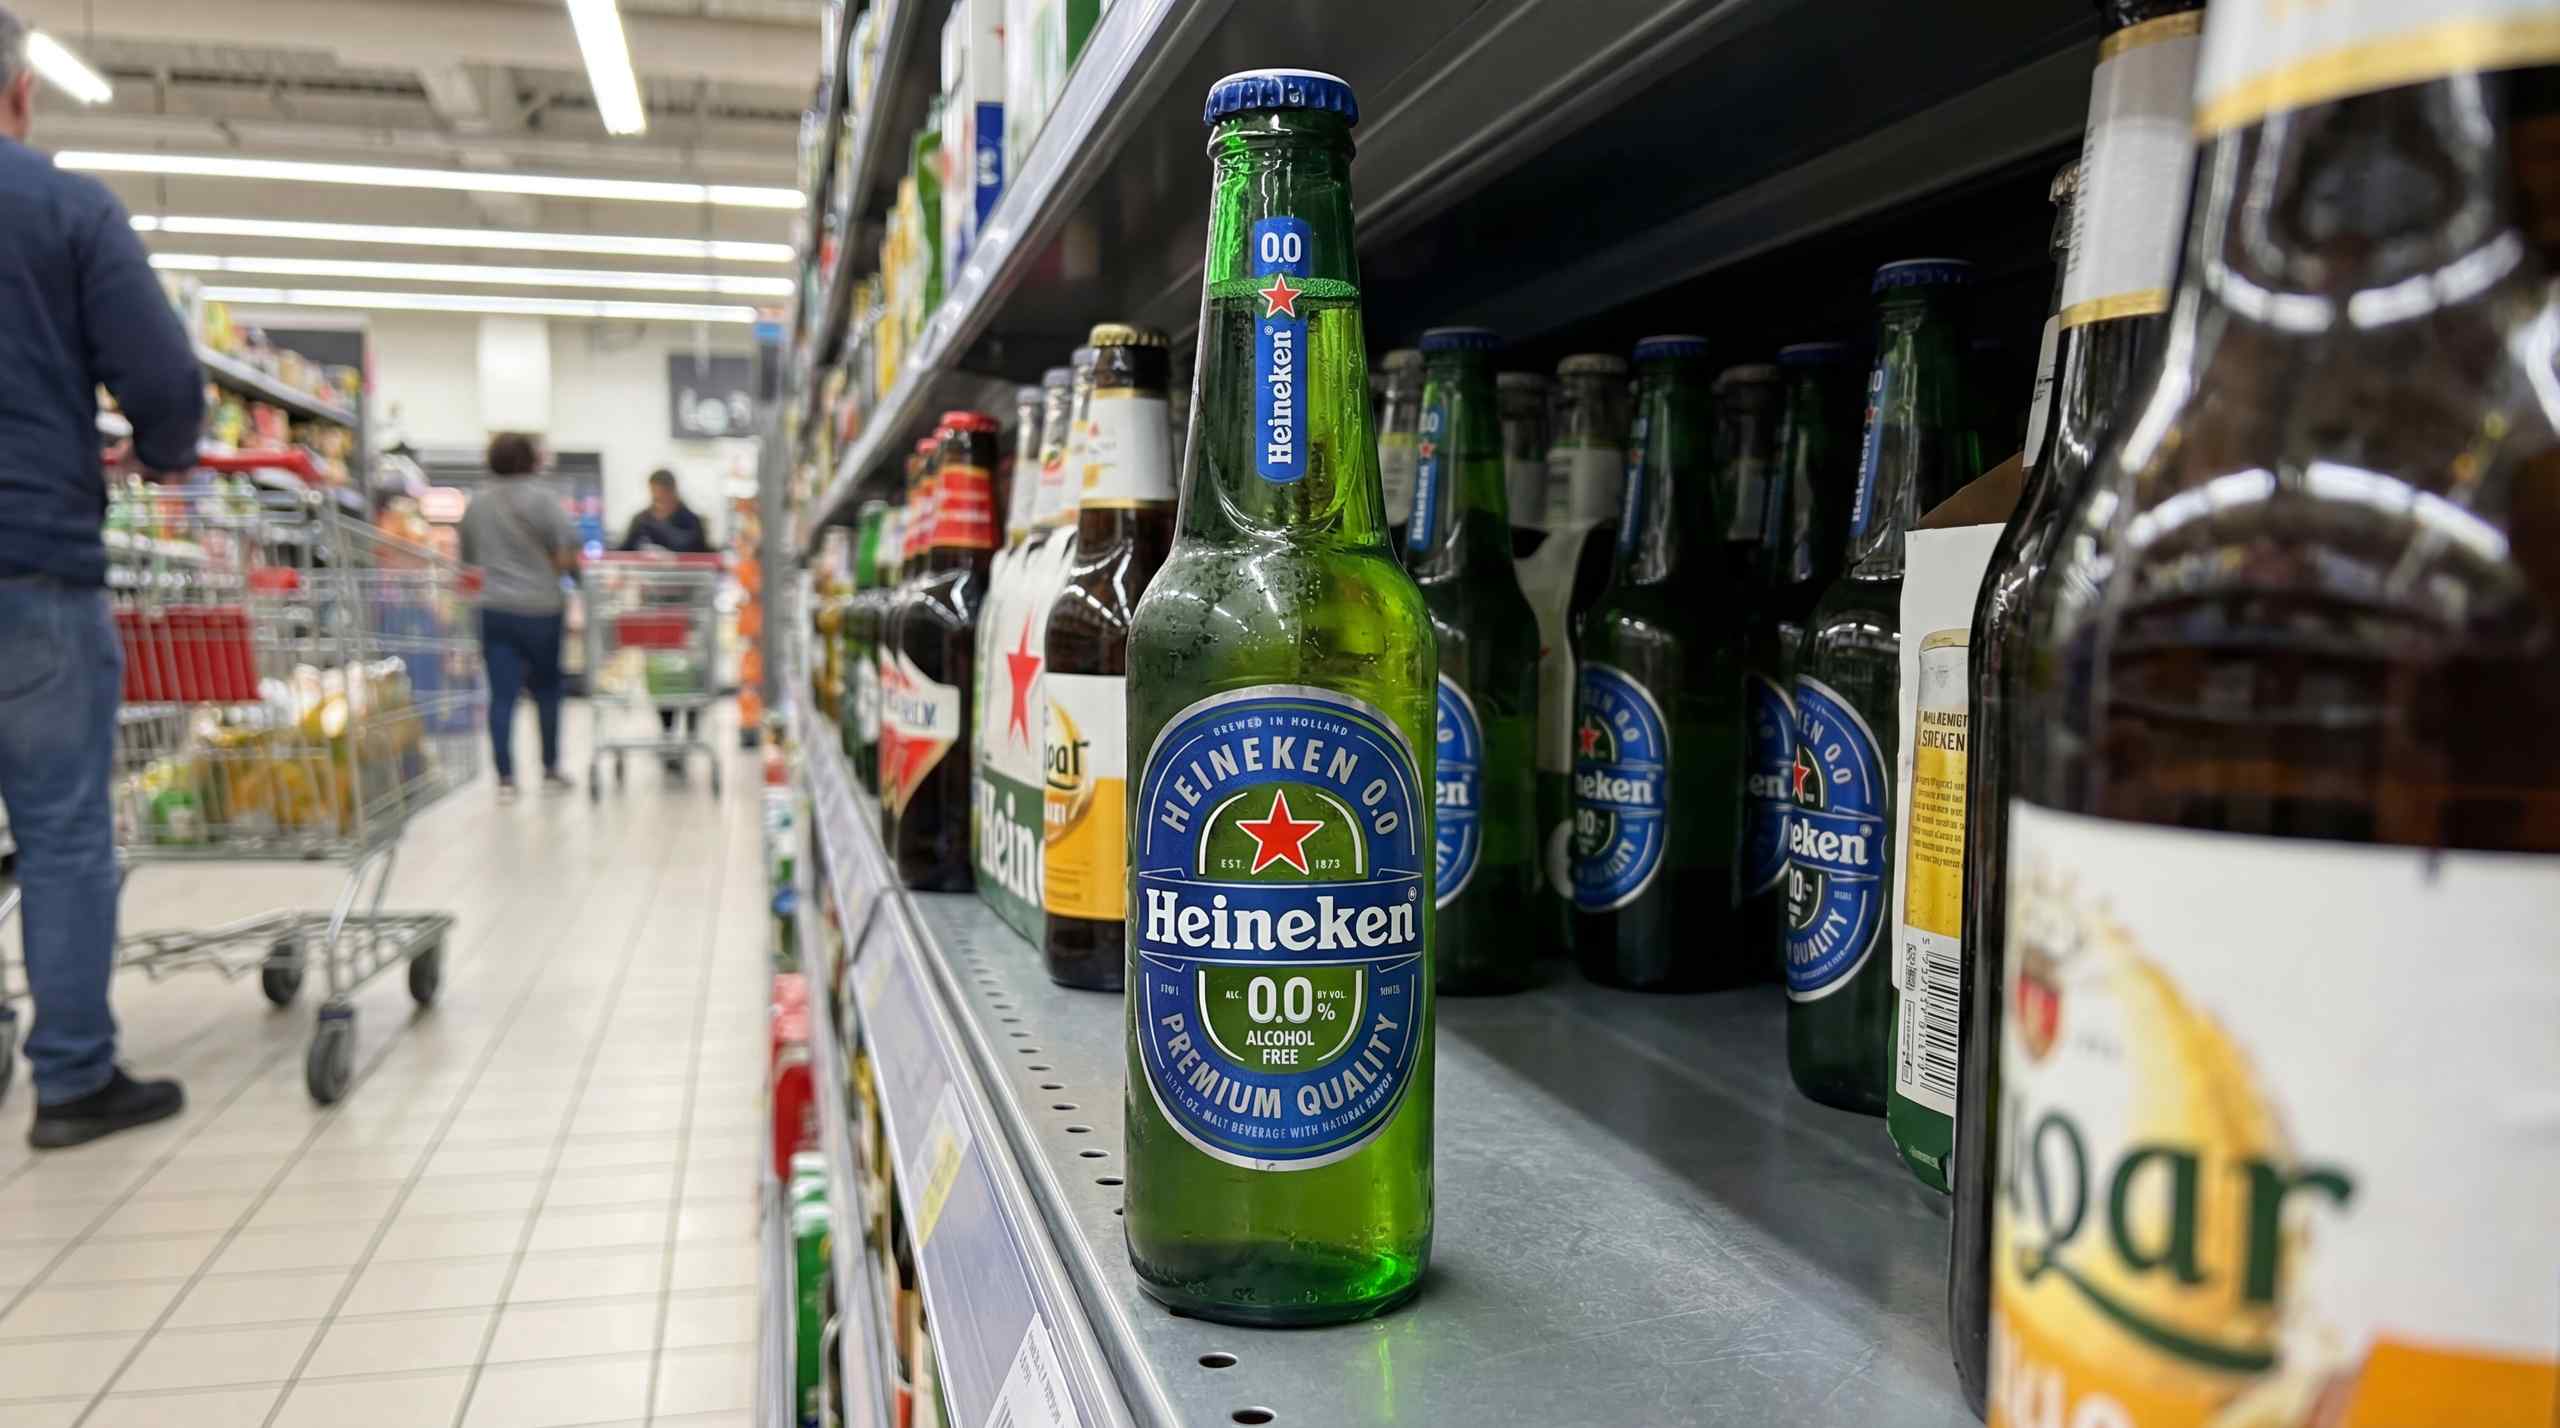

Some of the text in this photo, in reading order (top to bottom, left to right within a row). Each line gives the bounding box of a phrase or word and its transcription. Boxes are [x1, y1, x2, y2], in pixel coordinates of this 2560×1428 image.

[1260, 232, 1302, 264] 0.0
[1213, 716, 1348, 736] BREWED IN HOLLAND
[1161, 735, 1399, 836] HEINEKEN 0.0
[1221, 859, 1340, 869] EST. 1873
[1225, 990, 1243, 999] ALC.
[1247, 976, 1313, 1024] 0.0
[1317, 990, 1327, 999] BY
[1317, 1002, 1336, 1021] %
[1246, 1030, 1315, 1046] ALCOHOL
[1161, 1012, 1399, 1119] PREMIUM QUALITY
[1262, 1049, 1299, 1065] FREE
[1203, 1109, 1228, 1130] MALT
[1231, 1120, 1287, 1139] BEVERAGE
[1291, 1125, 1318, 1138] WITH
[1322, 1104, 1366, 1132] NATURAL
[1365, 1072, 1393, 1109] FLAVOR
